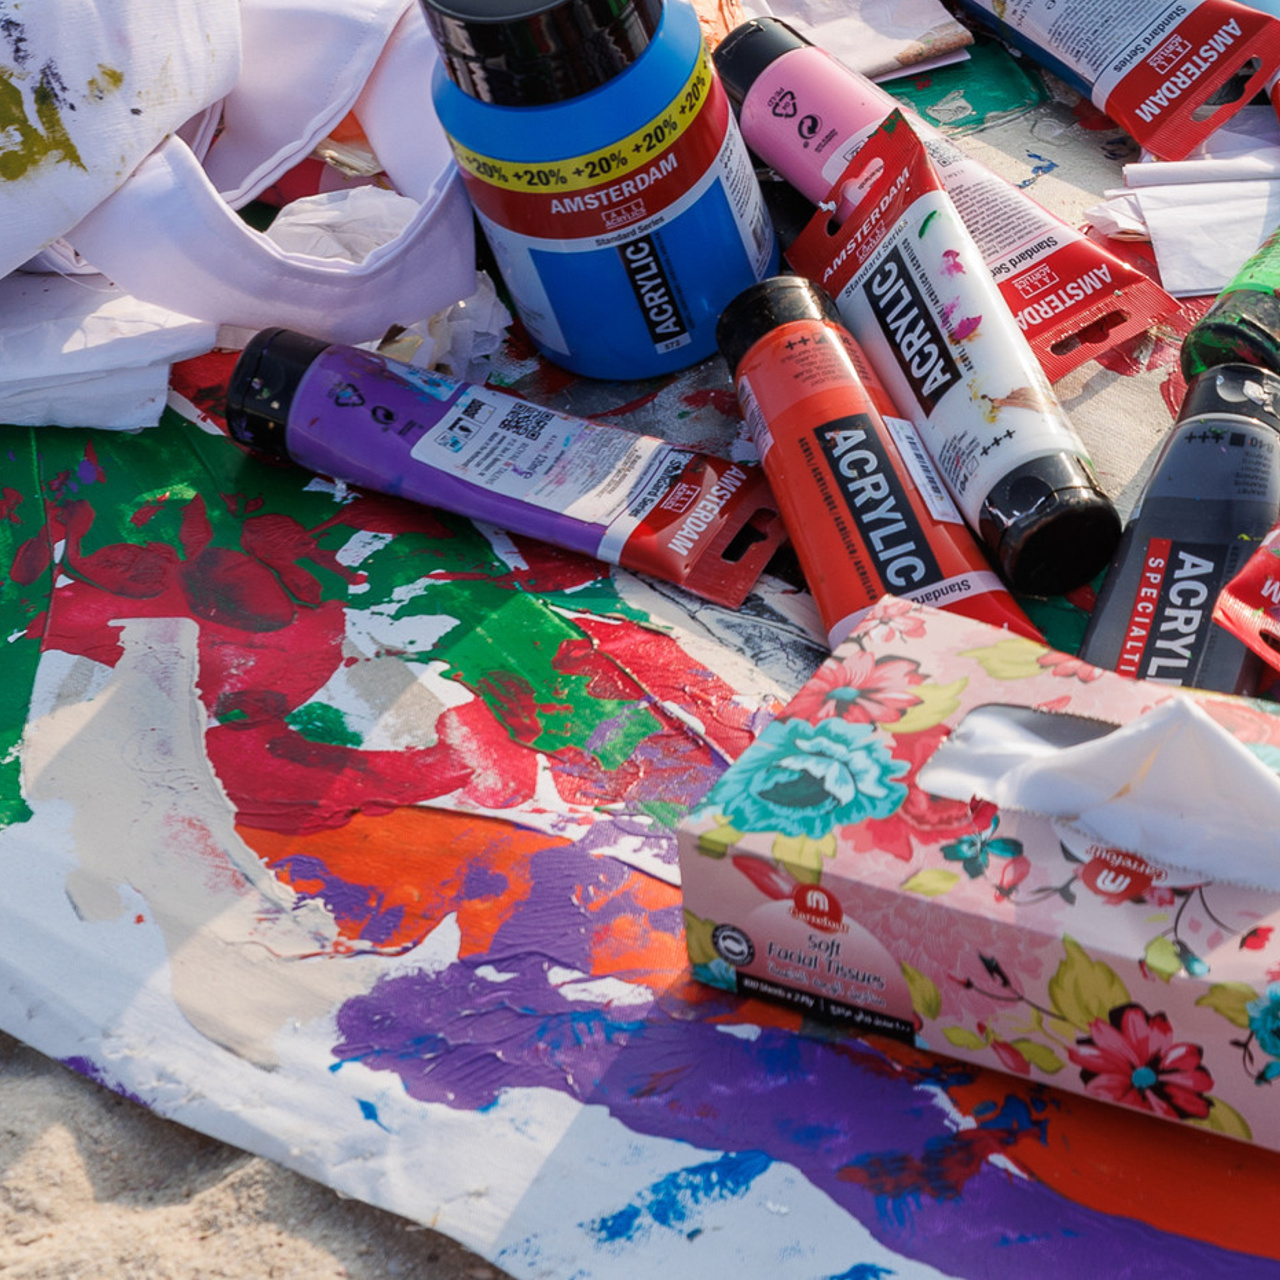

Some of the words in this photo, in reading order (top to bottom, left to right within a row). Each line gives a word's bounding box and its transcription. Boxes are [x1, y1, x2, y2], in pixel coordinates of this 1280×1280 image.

[1113, 43, 1147, 75] Series
[1142, 5, 1187, 50] Standard
[1147, 35, 1182, 67] ACRYLICS
[1134, 17, 1243, 123] AMSTERDAM
[513, 168, 567, 188] +20%
[572, 150, 628, 180] +20%
[632, 119, 678, 154] +20%
[679, 73, 706, 115] +20%
[550, 153, 678, 215] AMSTERDAM
[595, 226, 637, 247] Standard
[638, 216, 665, 237] Series
[823, 166, 911, 283] AMSTERDAM
[844, 252, 882, 299] Standard
[881, 221, 908, 253] Series
[1013, 236, 1059, 268] Standard
[625, 240, 681, 335] ACRYLIC
[1014, 264, 1113, 328] AMSTERDA
[872, 261, 949, 398] ACRYLIC
[667, 464, 747, 557] AMSTERDAM
[824, 429, 927, 588] ACRYLIC
[1119, 556, 1165, 674] SPECIALTI
[1147, 551, 1215, 684] ACRYL
[1085, 844, 1168, 882] Carrefour
[767, 942, 819, 969] Facial
[826, 957, 886, 990] Tissues
[808, 934, 841, 955] Soft
